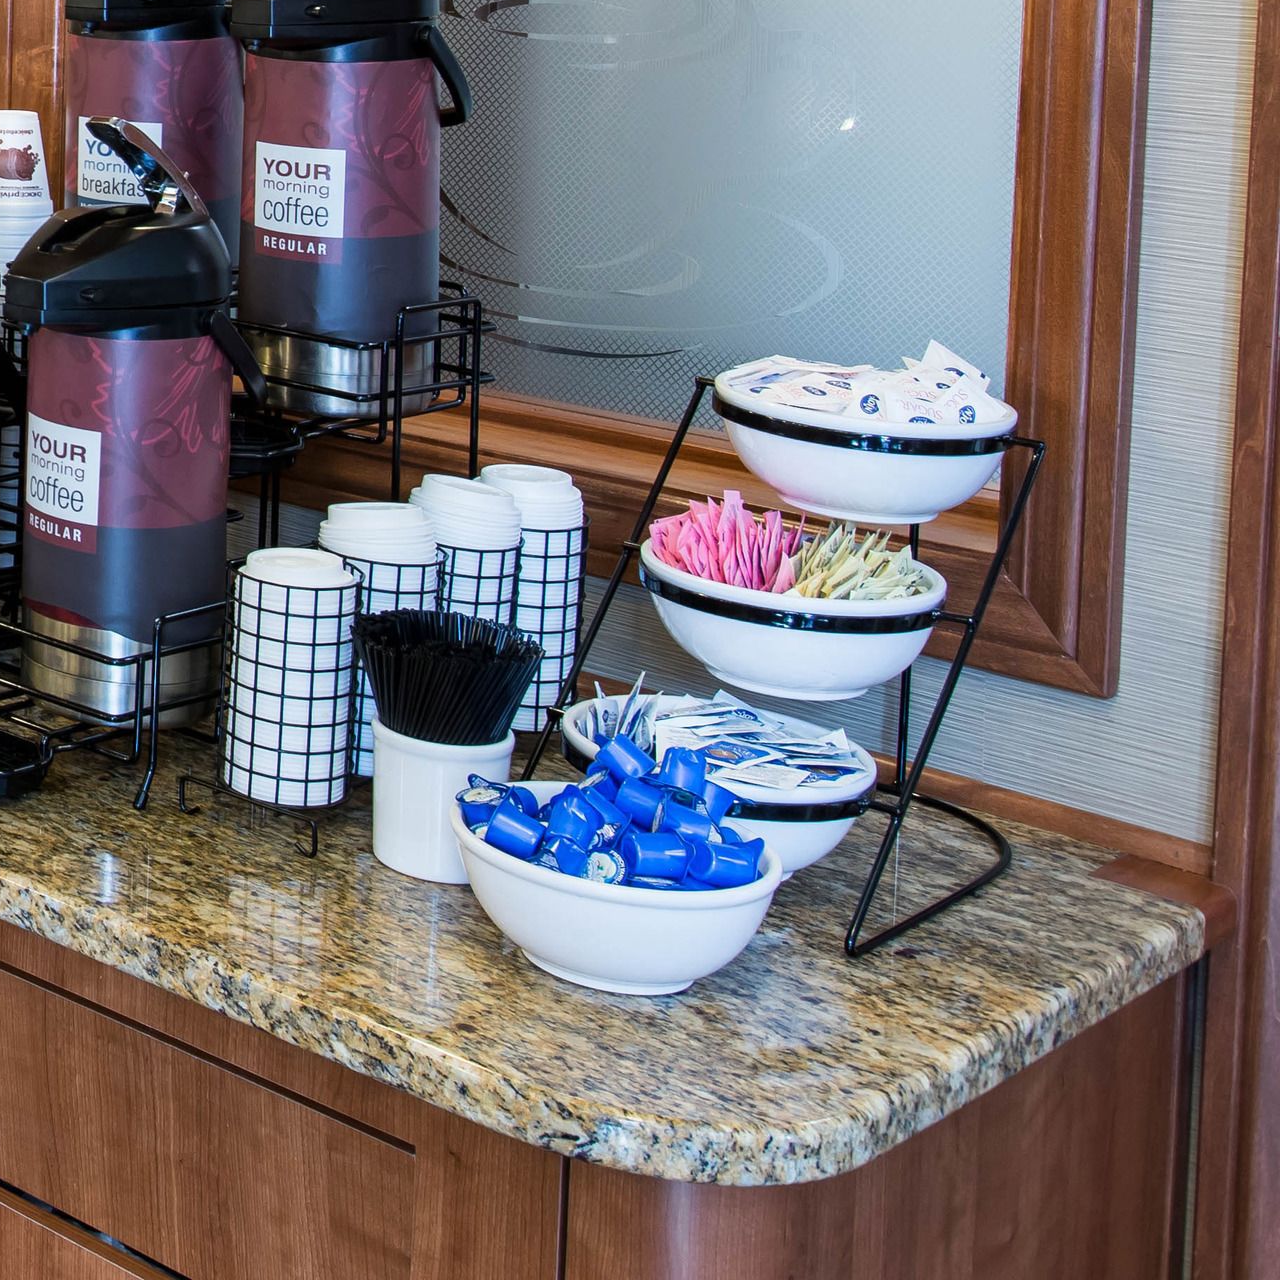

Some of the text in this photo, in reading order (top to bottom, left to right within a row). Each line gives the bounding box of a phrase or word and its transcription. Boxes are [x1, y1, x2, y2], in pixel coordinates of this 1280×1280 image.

[263, 157, 331, 181] YOUR
[82, 173, 145, 198] breakfas
[263, 178, 330, 199] morning
[263, 196, 329, 228] coffee
[263, 234, 327, 256] REGULAR
[31, 429, 87, 463] YOUR
[31, 452, 85, 482] morning
[30, 475, 84, 512] coffee
[28, 512, 82, 543] REGULAR
